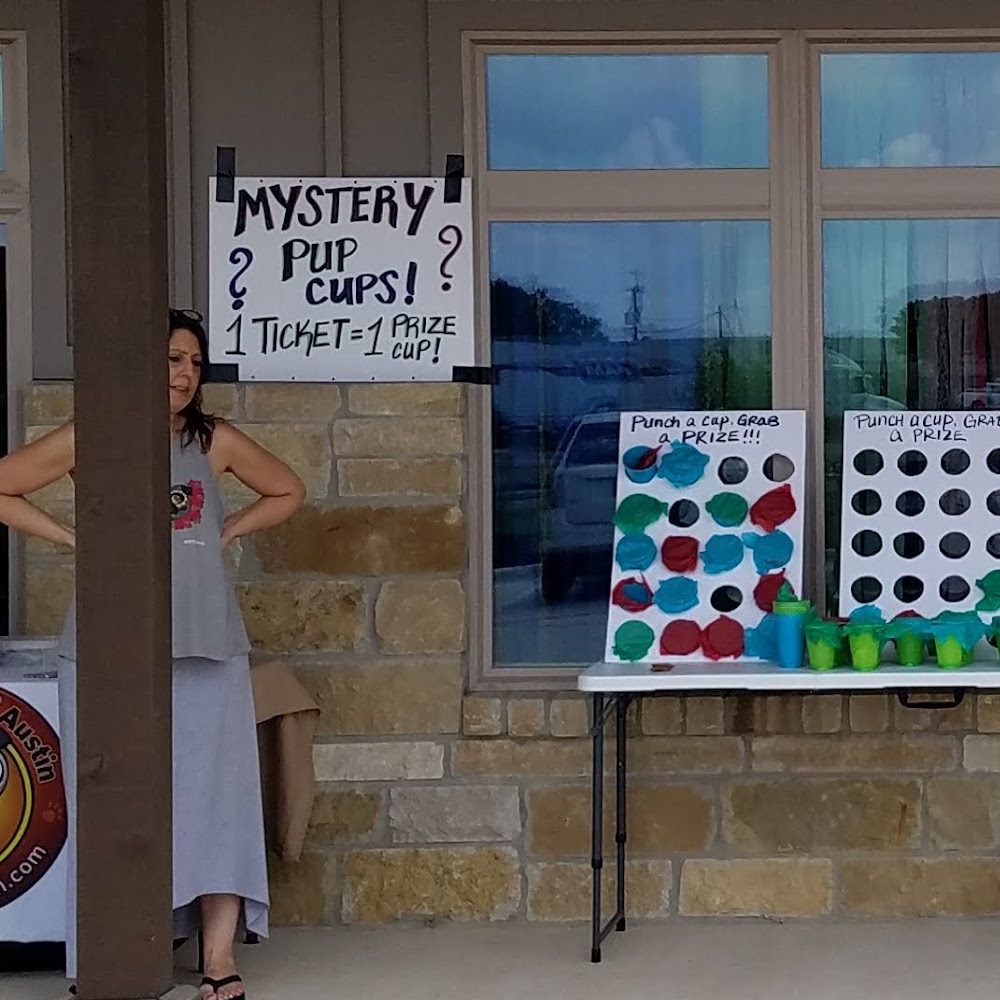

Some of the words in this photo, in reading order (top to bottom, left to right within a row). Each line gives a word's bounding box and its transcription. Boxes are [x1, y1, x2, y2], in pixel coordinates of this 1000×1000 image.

[234, 182, 435, 237] MYSTERY
[281, 237, 358, 282] PUP
[306, 261, 418, 305] CUPS!
[225, 314, 246, 355] 1
[392, 313, 456, 339] PRIZE
[631, 414, 680, 432] Punch
[686, 417, 696, 427] a
[658, 432, 671, 444] a
[682, 429, 761, 445] PRIZE!!!
[913, 429, 968, 443] PRIZE
[0, 705, 58, 784] Austin
